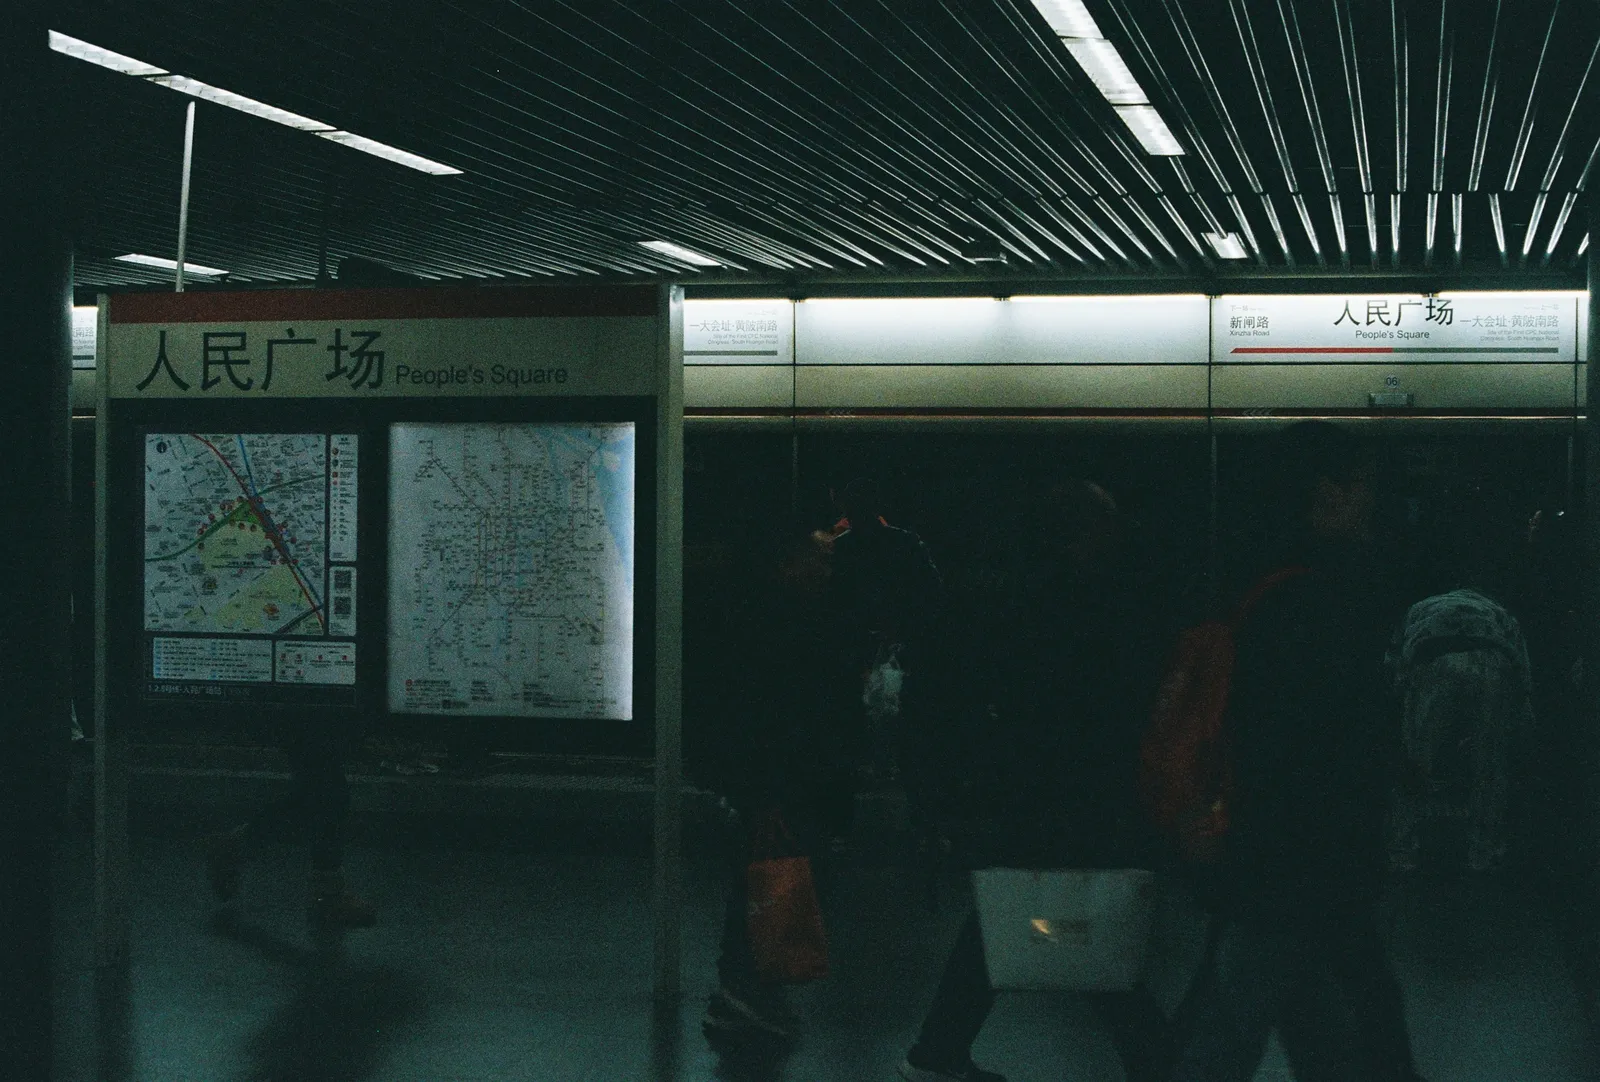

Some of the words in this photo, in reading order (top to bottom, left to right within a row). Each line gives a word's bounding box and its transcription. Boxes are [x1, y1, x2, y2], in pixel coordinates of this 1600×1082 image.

[1334, 297, 1454, 327] 人民广场
[1230, 316, 1269, 329] 新闸路
[1355, 330, 1394, 341] People's
[1396, 330, 1430, 341] Square
[135, 327, 386, 391] 人民广场
[396, 364, 484, 386] People's
[491, 364, 568, 386] Square
[1385, 376, 1398, 386] 06
